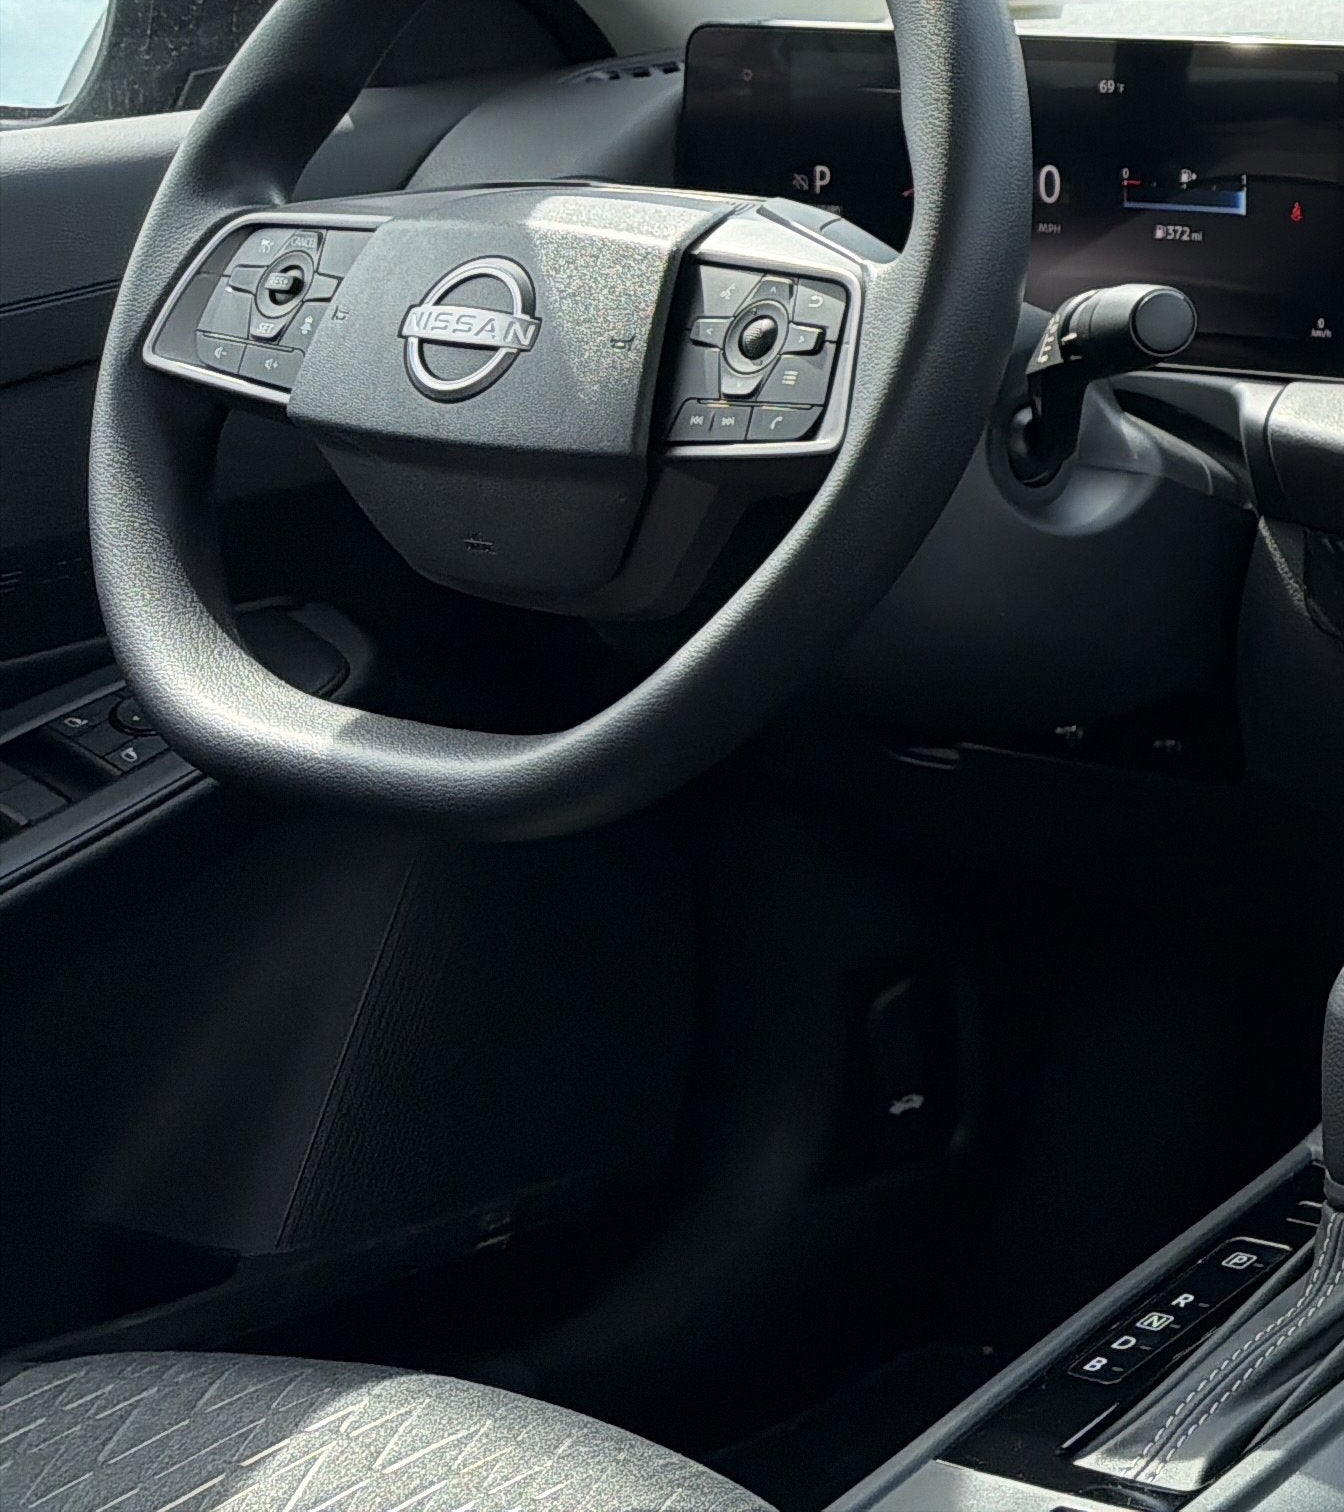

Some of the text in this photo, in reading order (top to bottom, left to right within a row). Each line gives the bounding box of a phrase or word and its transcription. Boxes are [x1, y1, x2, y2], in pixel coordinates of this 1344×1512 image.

[1099, 79, 1115, 93] 69
[814, 164, 831, 194] P
[1039, 164, 1061, 204] 0
[1038, 223, 1062, 233] MPH
[1166, 226, 1190, 241] 372
[404, 310, 537, 346] NISSAN
[1171, 1293, 1195, 1308] R
[1110, 1335, 1136, 1350] D
[1082, 1356, 1108, 1372] B
